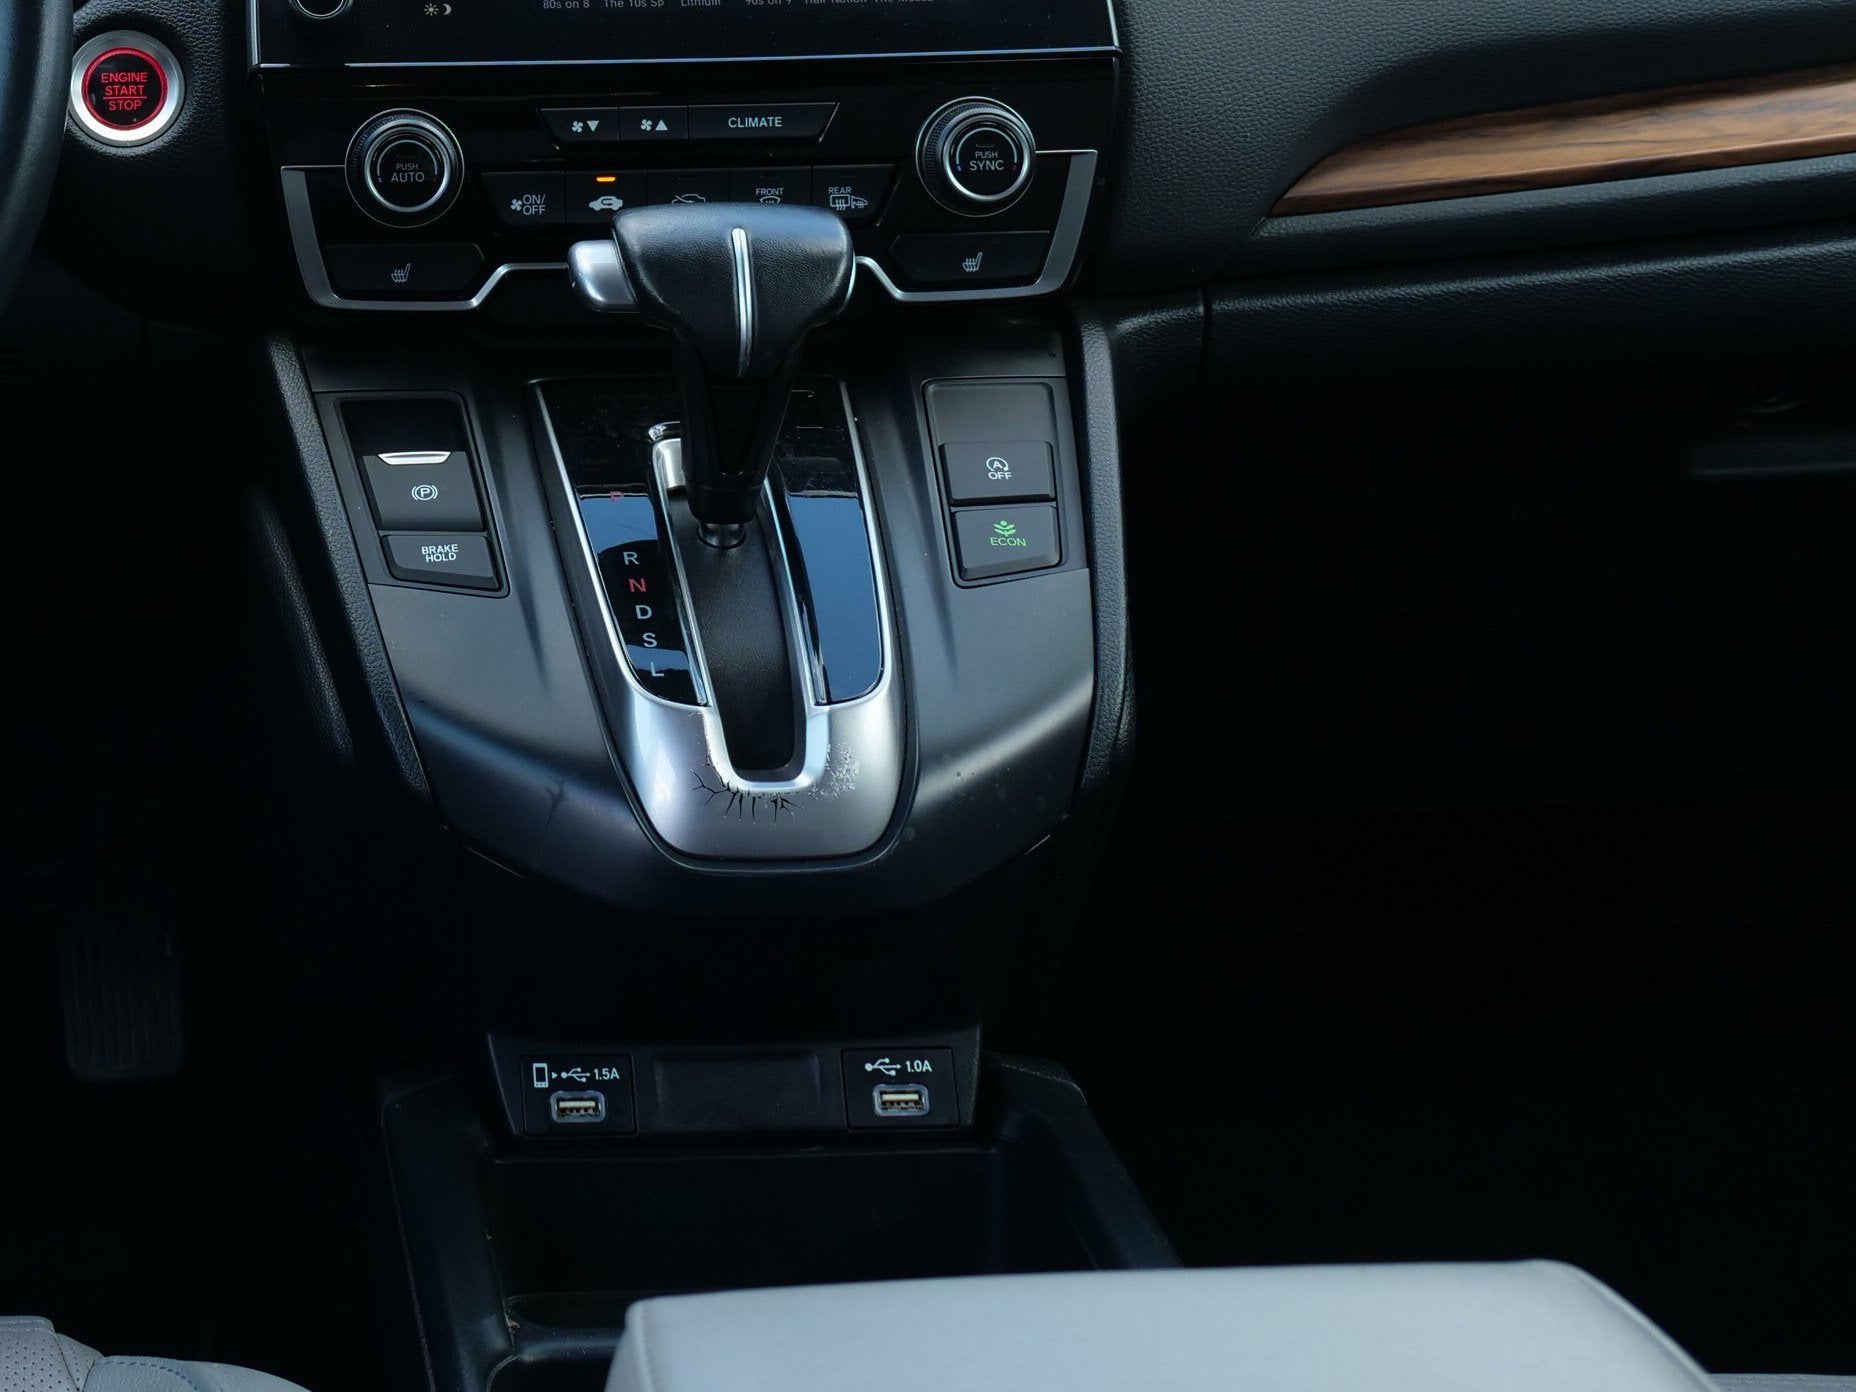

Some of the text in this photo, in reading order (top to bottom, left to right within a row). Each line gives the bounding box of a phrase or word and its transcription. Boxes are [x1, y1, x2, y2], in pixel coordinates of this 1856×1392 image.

[565, 0, 580, 9] on
[101, 72, 148, 83] ENGINE
[105, 85, 144, 96] START
[109, 99, 142, 111] STOP
[727, 116, 783, 129] CLIMATE
[975, 151, 998, 159] PUSH
[395, 163, 419, 171] PUSH
[969, 160, 1004, 172] SYNC
[390, 171, 425, 183] AUTO
[755, 187, 784, 197] FRONT
[828, 186, 852, 195] REAR
[522, 194, 546, 205] ON/
[522, 205, 546, 216] OFF
[988, 471, 1012, 480] OFF
[989, 537, 1027, 547] ECON
[421, 544, 459, 555] BRAKE
[425, 552, 457, 563] HOLD
[623, 551, 641, 565] R
[629, 578, 648, 593] N
[635, 604, 653, 620] D
[643, 632, 658, 648] S
[650, 661, 665, 677] L
[905, 1059, 933, 1074] 1.0A
[593, 1066, 620, 1081] 1.5A
